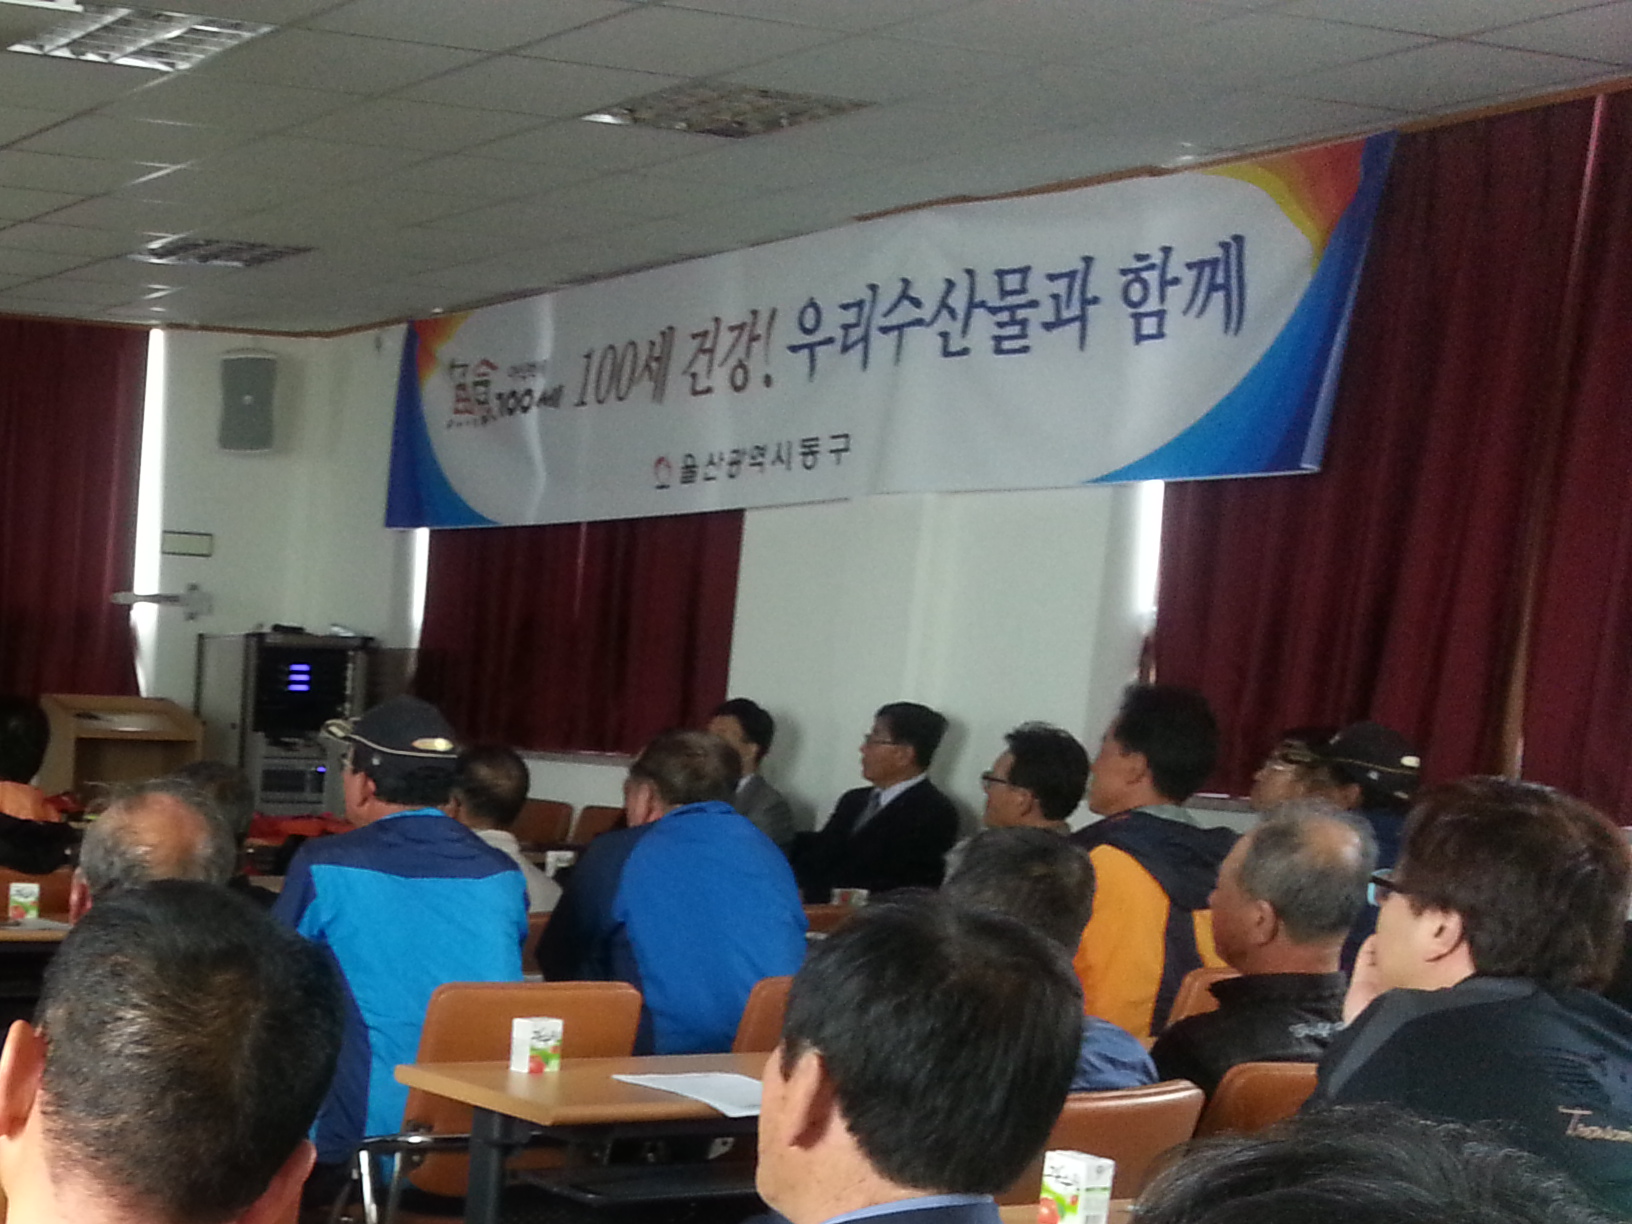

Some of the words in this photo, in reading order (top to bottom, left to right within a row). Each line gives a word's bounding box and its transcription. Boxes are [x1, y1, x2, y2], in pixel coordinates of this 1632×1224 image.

[573, 325, 676, 408] 100세
[682, 307, 778, 397] 건강!
[1117, 233, 1247, 346] 함께
